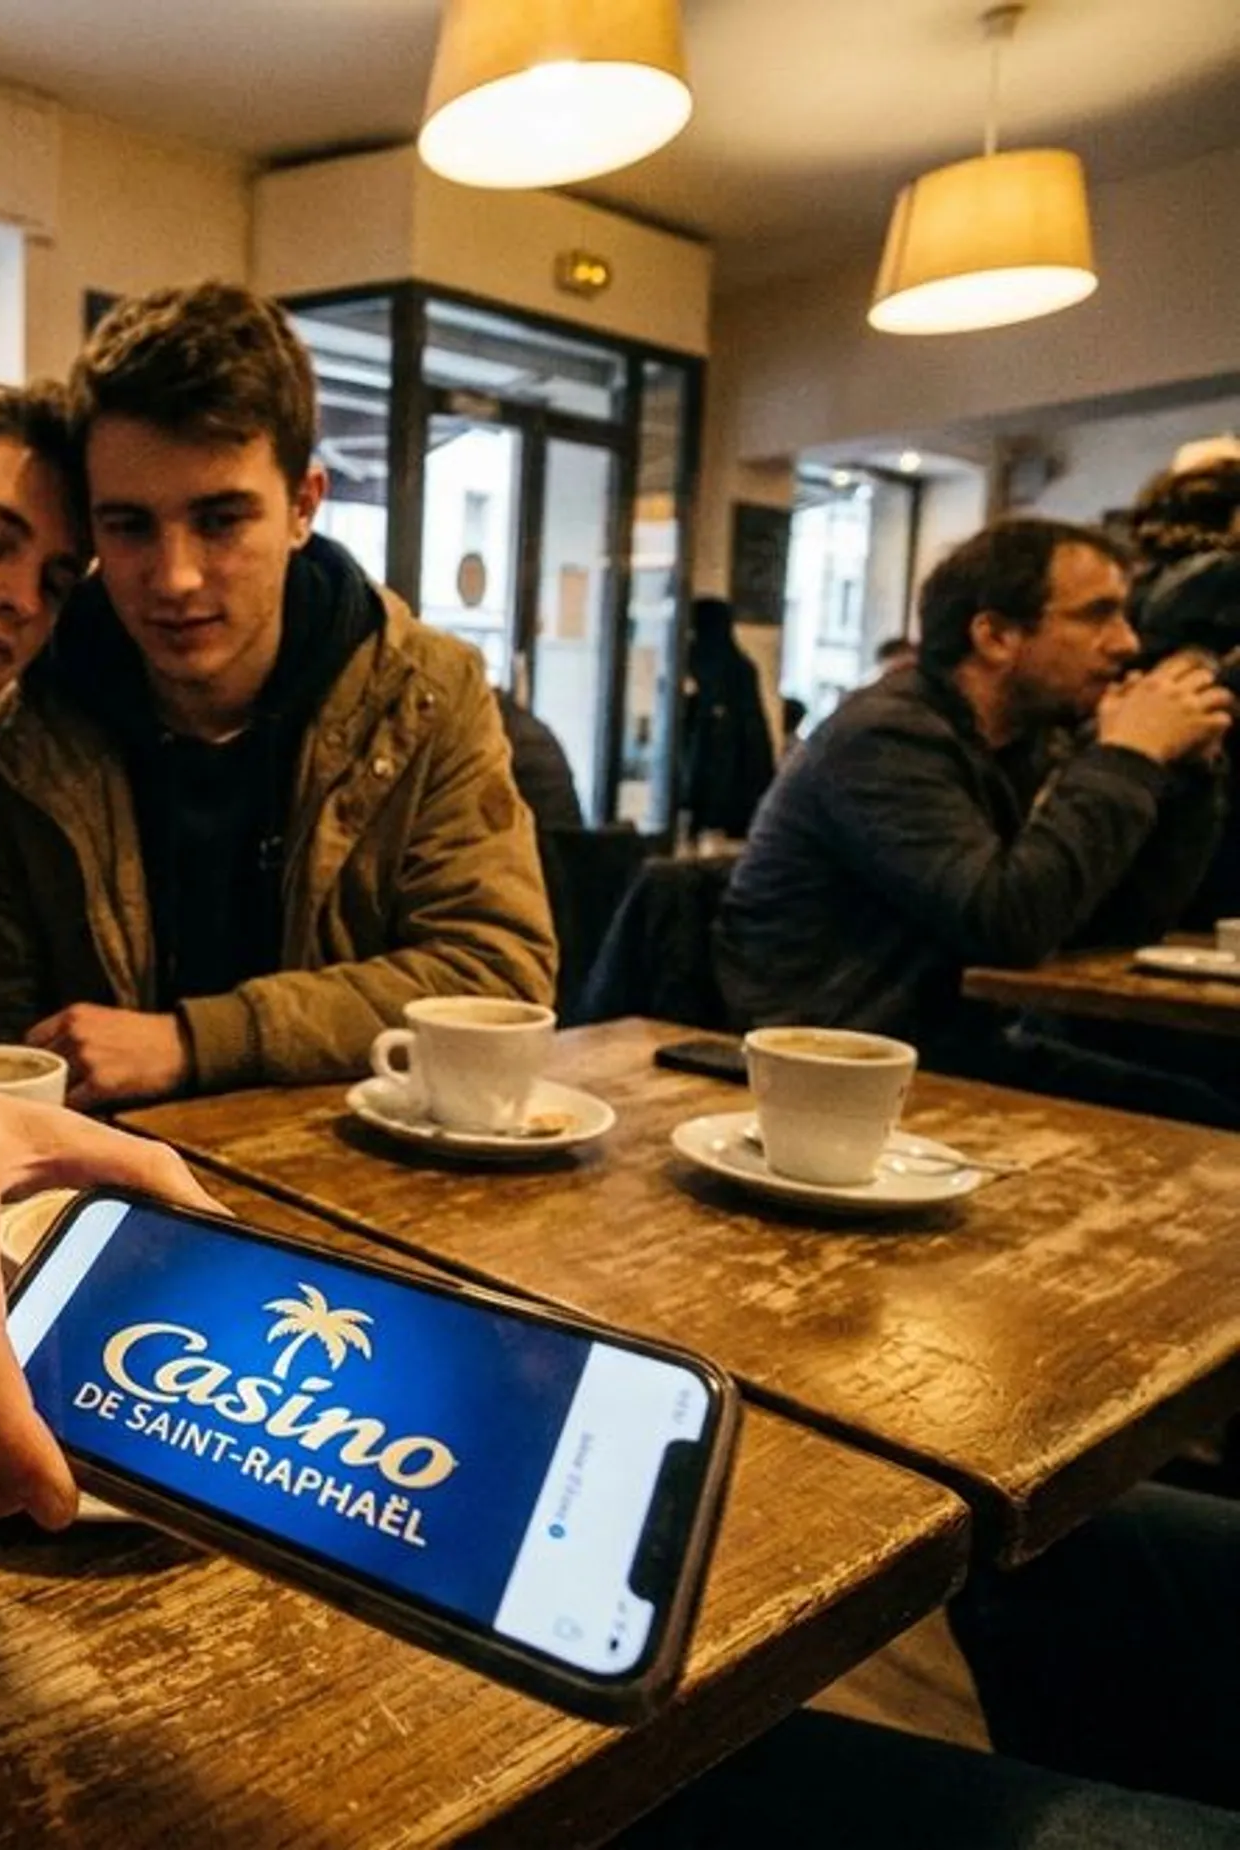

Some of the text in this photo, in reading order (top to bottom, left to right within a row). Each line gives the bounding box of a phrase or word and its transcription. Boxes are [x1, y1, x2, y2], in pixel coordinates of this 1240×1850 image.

[74, 1382, 426, 1547] DE SAINT-RAPHAËL
[103, 1323, 457, 1488] Casino
